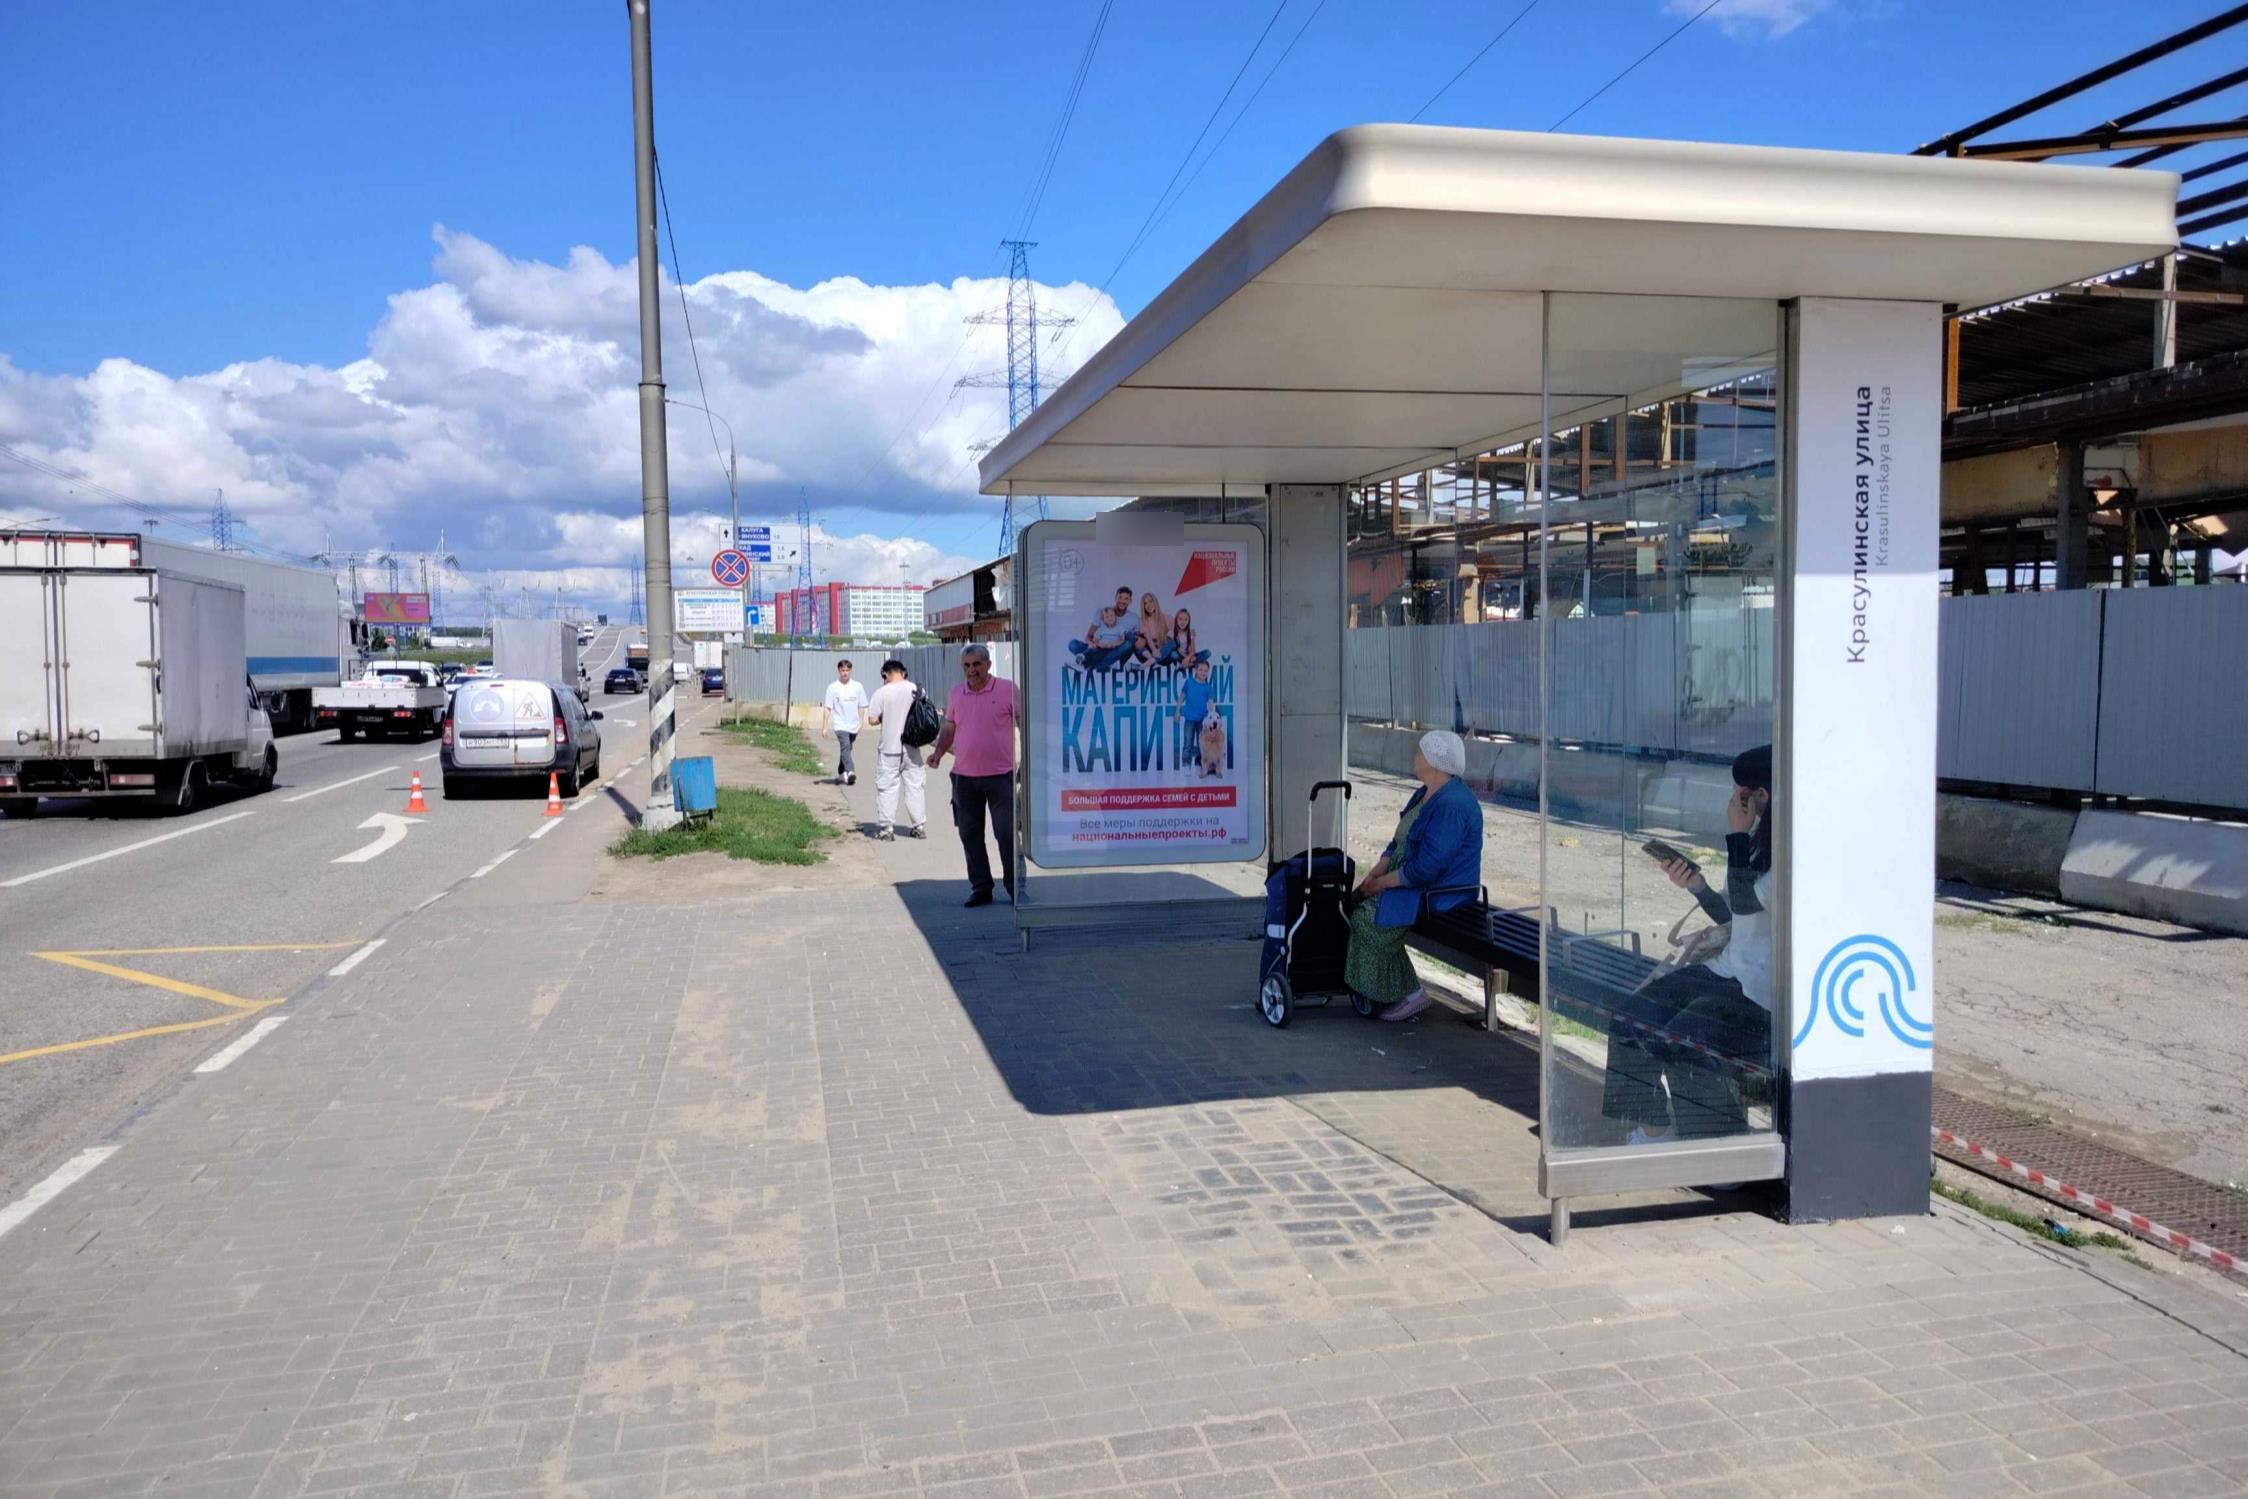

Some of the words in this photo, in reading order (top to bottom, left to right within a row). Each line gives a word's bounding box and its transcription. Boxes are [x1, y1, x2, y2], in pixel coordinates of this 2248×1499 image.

[1856, 385, 1874, 467] улица
[1877, 386, 1892, 438] Ulitsa
[1875, 443, 1893, 566] Krasulinskaya
[1847, 474, 1871, 664] Красулинская
[1062, 655, 1234, 705] МАТЕРИНСИЙ
[1068, 795, 1108, 805] БОЛЬШАЯ
[1109, 794, 1161, 805] ПОДДЕРЖКА
[1162, 792, 1189, 802] СЕМЕЙ
[1190, 793, 1196, 802] С
[1197, 792, 1230, 803] ДЕТЬМИ
[1080, 819, 1101, 829] Все
[1103, 819, 1136, 830] меры
[1139, 817, 1203, 829] поддержки
[1206, 816, 1220, 826] на
[1072, 827, 1227, 842] национальныепроекты.рф
